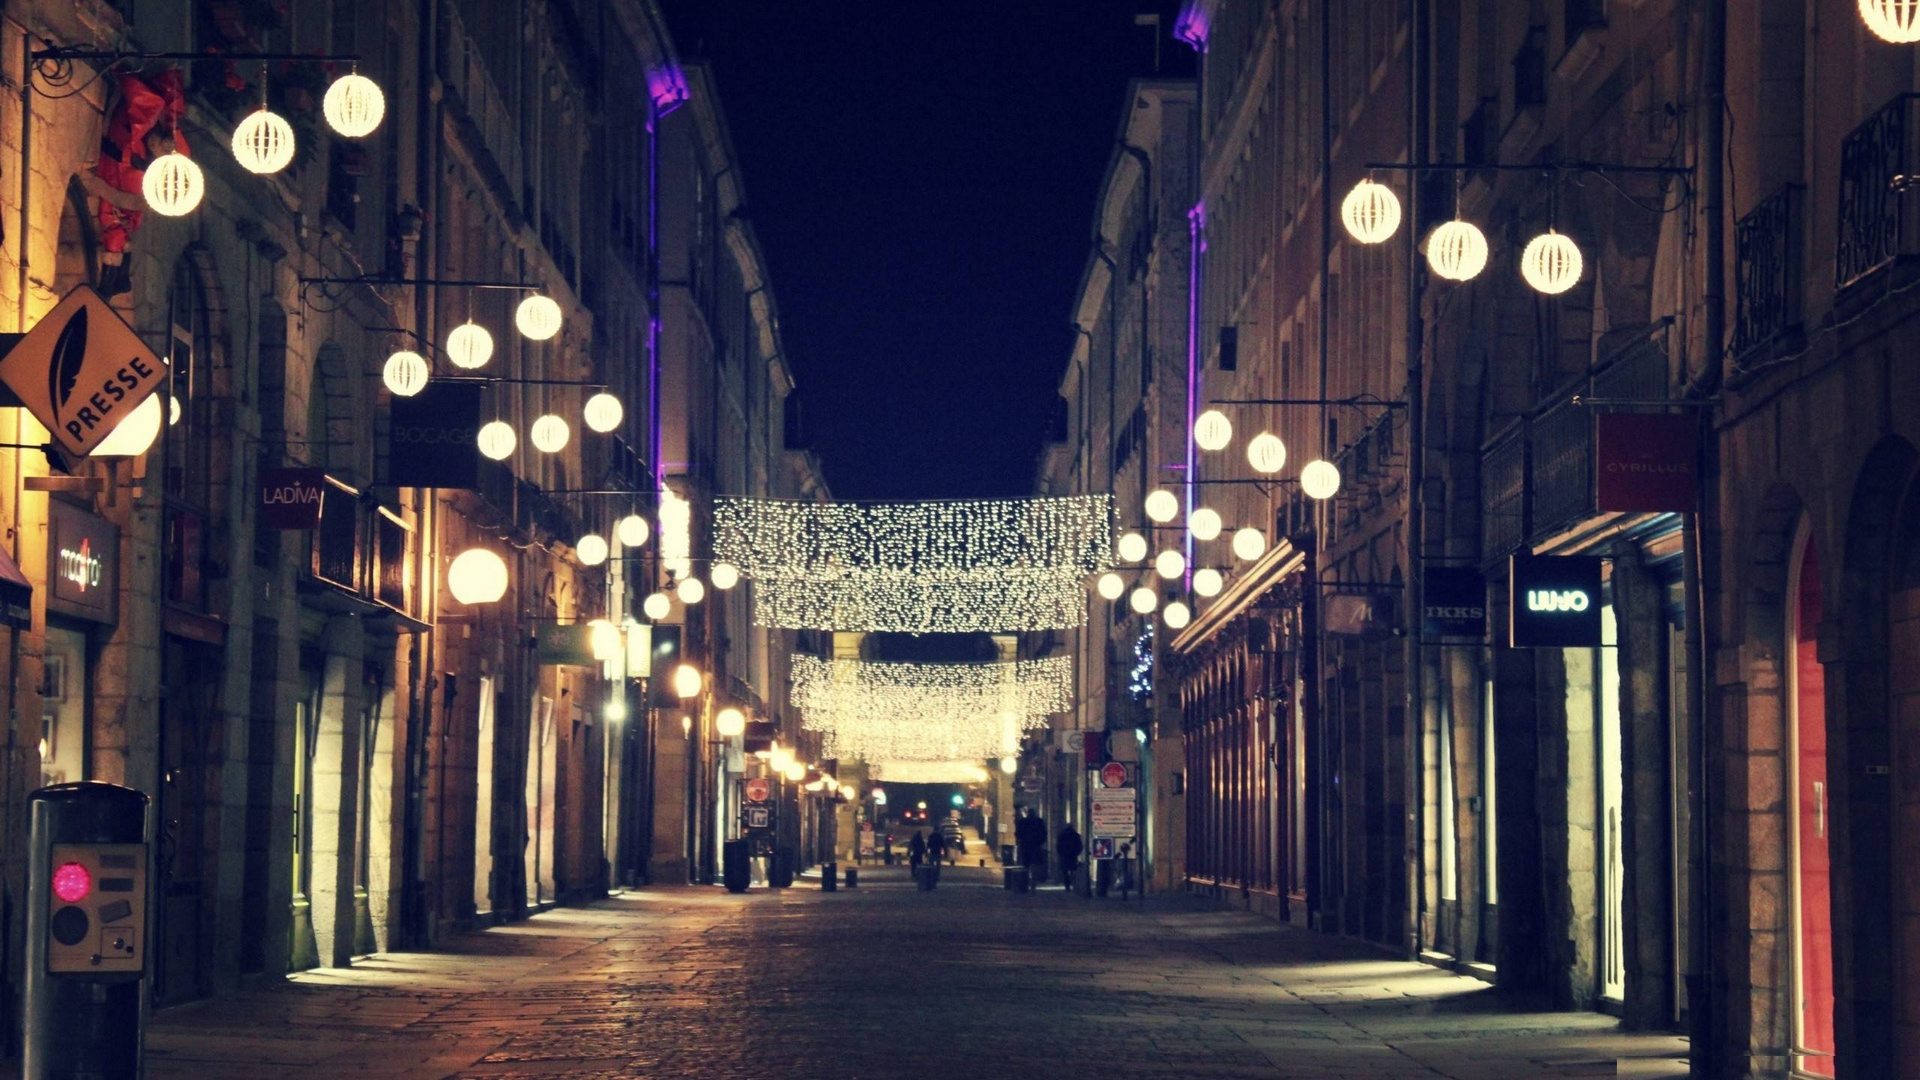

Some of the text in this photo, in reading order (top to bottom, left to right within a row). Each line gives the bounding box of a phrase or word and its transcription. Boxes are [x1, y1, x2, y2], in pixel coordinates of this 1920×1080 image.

[65, 357, 153, 443] PRESSE
[395, 425, 475, 444] BOCAGE
[1607, 462, 1688, 474] CYRILLUS
[263, 485, 320, 504] LADIVA
[1425, 606, 1484, 619] IKKS
